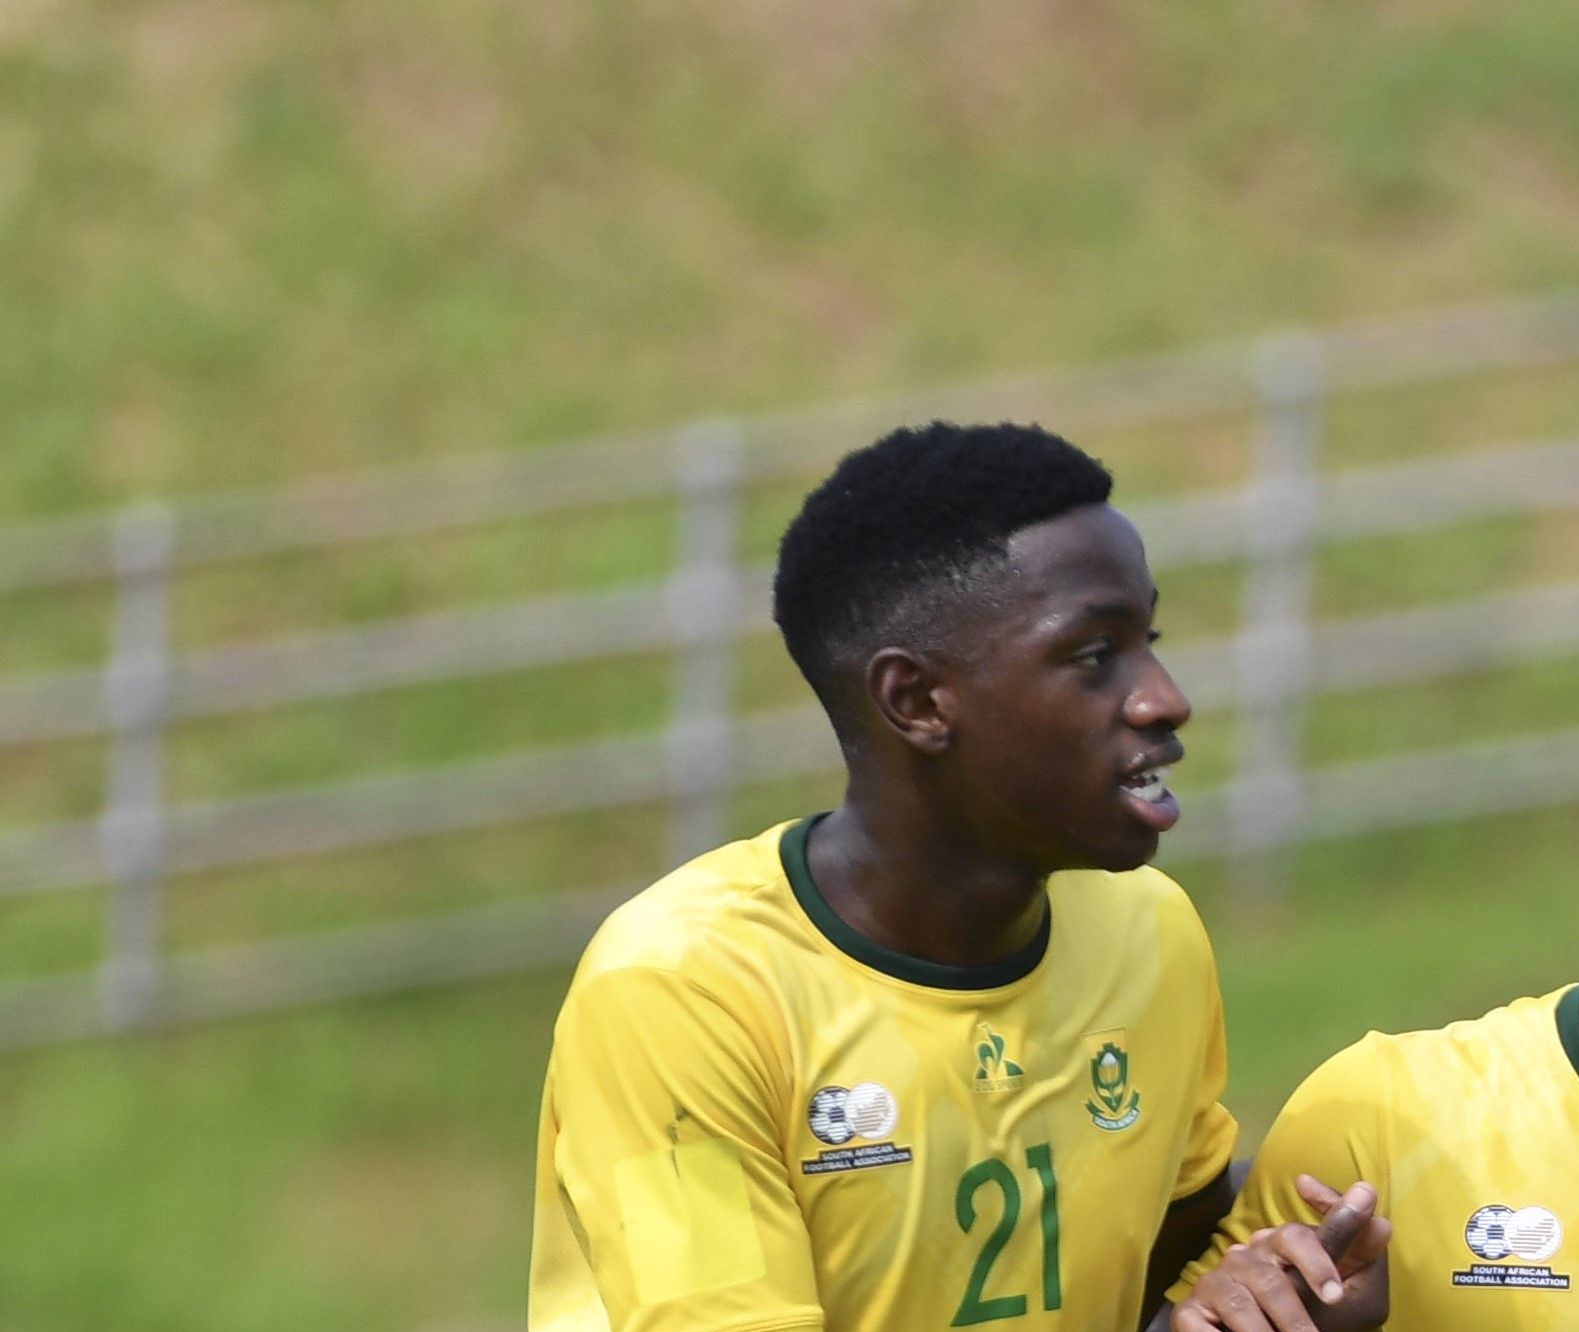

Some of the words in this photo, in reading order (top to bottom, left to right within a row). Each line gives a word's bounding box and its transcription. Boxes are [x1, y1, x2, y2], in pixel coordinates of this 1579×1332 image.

[950, 1142, 1062, 1327] 21
[1472, 1266, 1505, 1275] SOUTH
[1507, 1267, 1549, 1276] AFRICAN
[1454, 1275, 1502, 1284] FOOTBALL
[1504, 1276, 1568, 1287] ASSOCIATION
